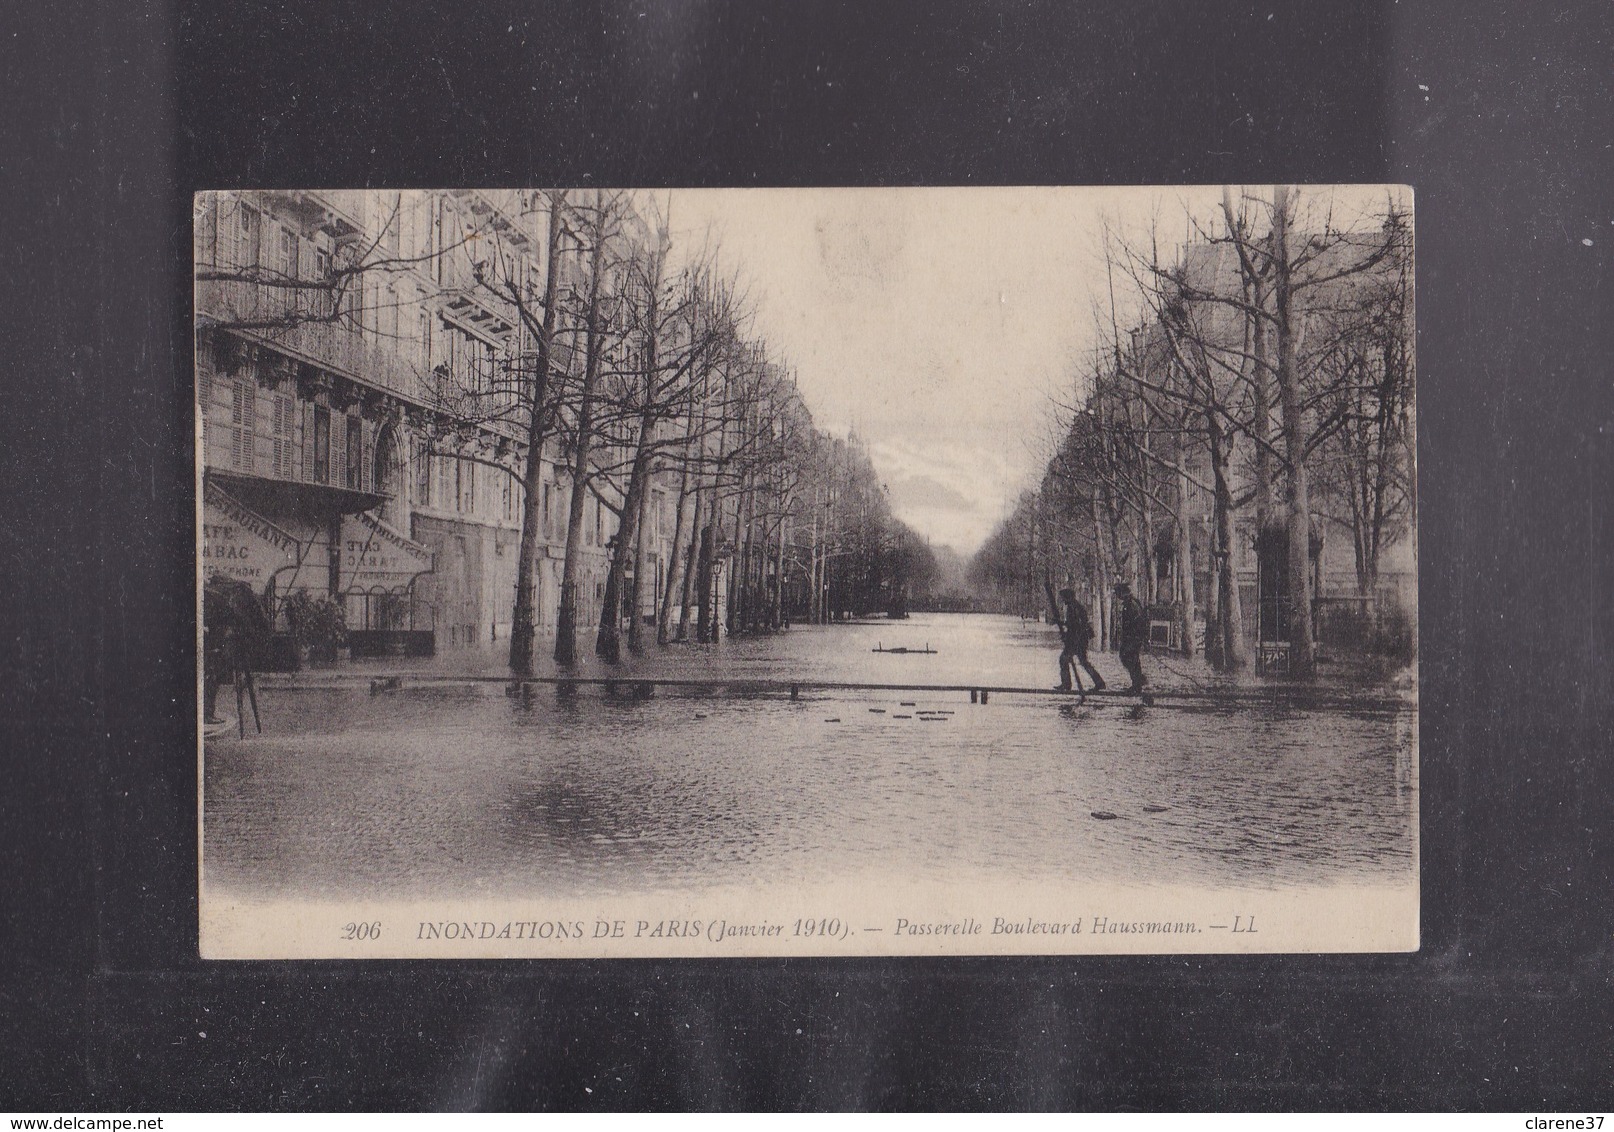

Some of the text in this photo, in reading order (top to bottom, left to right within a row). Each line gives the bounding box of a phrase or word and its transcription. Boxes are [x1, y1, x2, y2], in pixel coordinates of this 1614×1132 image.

[345, 921, 382, 940] 206
[416, 921, 585, 940] INONDATIONS
[592, 920, 626, 938] DE
[634, 920, 701, 938] PARIS
[707, 919, 785, 942] (Janvier
[793, 918, 856, 940] 1910).
[894, 918, 983, 936] Passerelle
[990, 917, 1083, 935] Boulevard
[1090, 917, 1203, 934] Haussmann.
